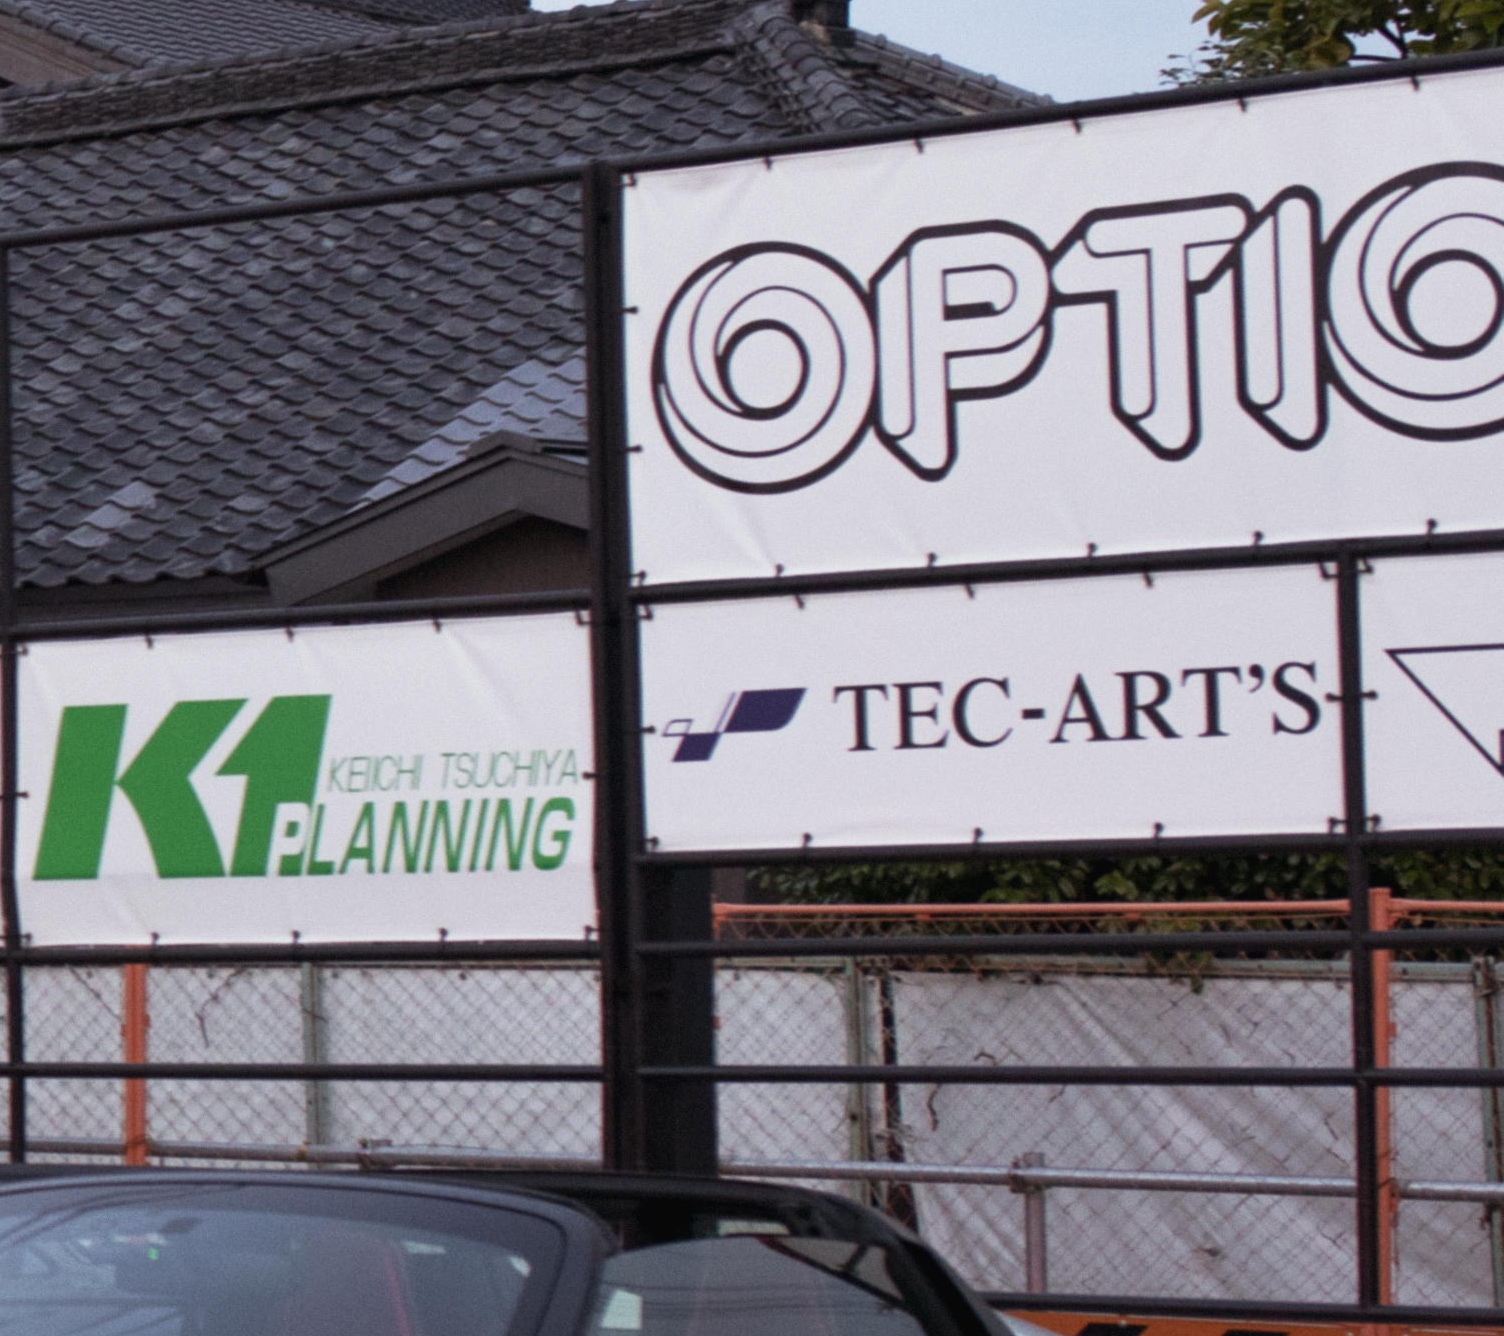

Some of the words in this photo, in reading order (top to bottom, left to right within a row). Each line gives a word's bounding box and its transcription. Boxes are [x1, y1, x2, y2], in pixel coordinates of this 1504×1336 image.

[833, 661, 1322, 753] TEC-ART'S
[327, 754, 425, 794] KEIICHI
[440, 748, 580, 790] TSUCHIYA
[269, 797, 576, 876] PLANNING
